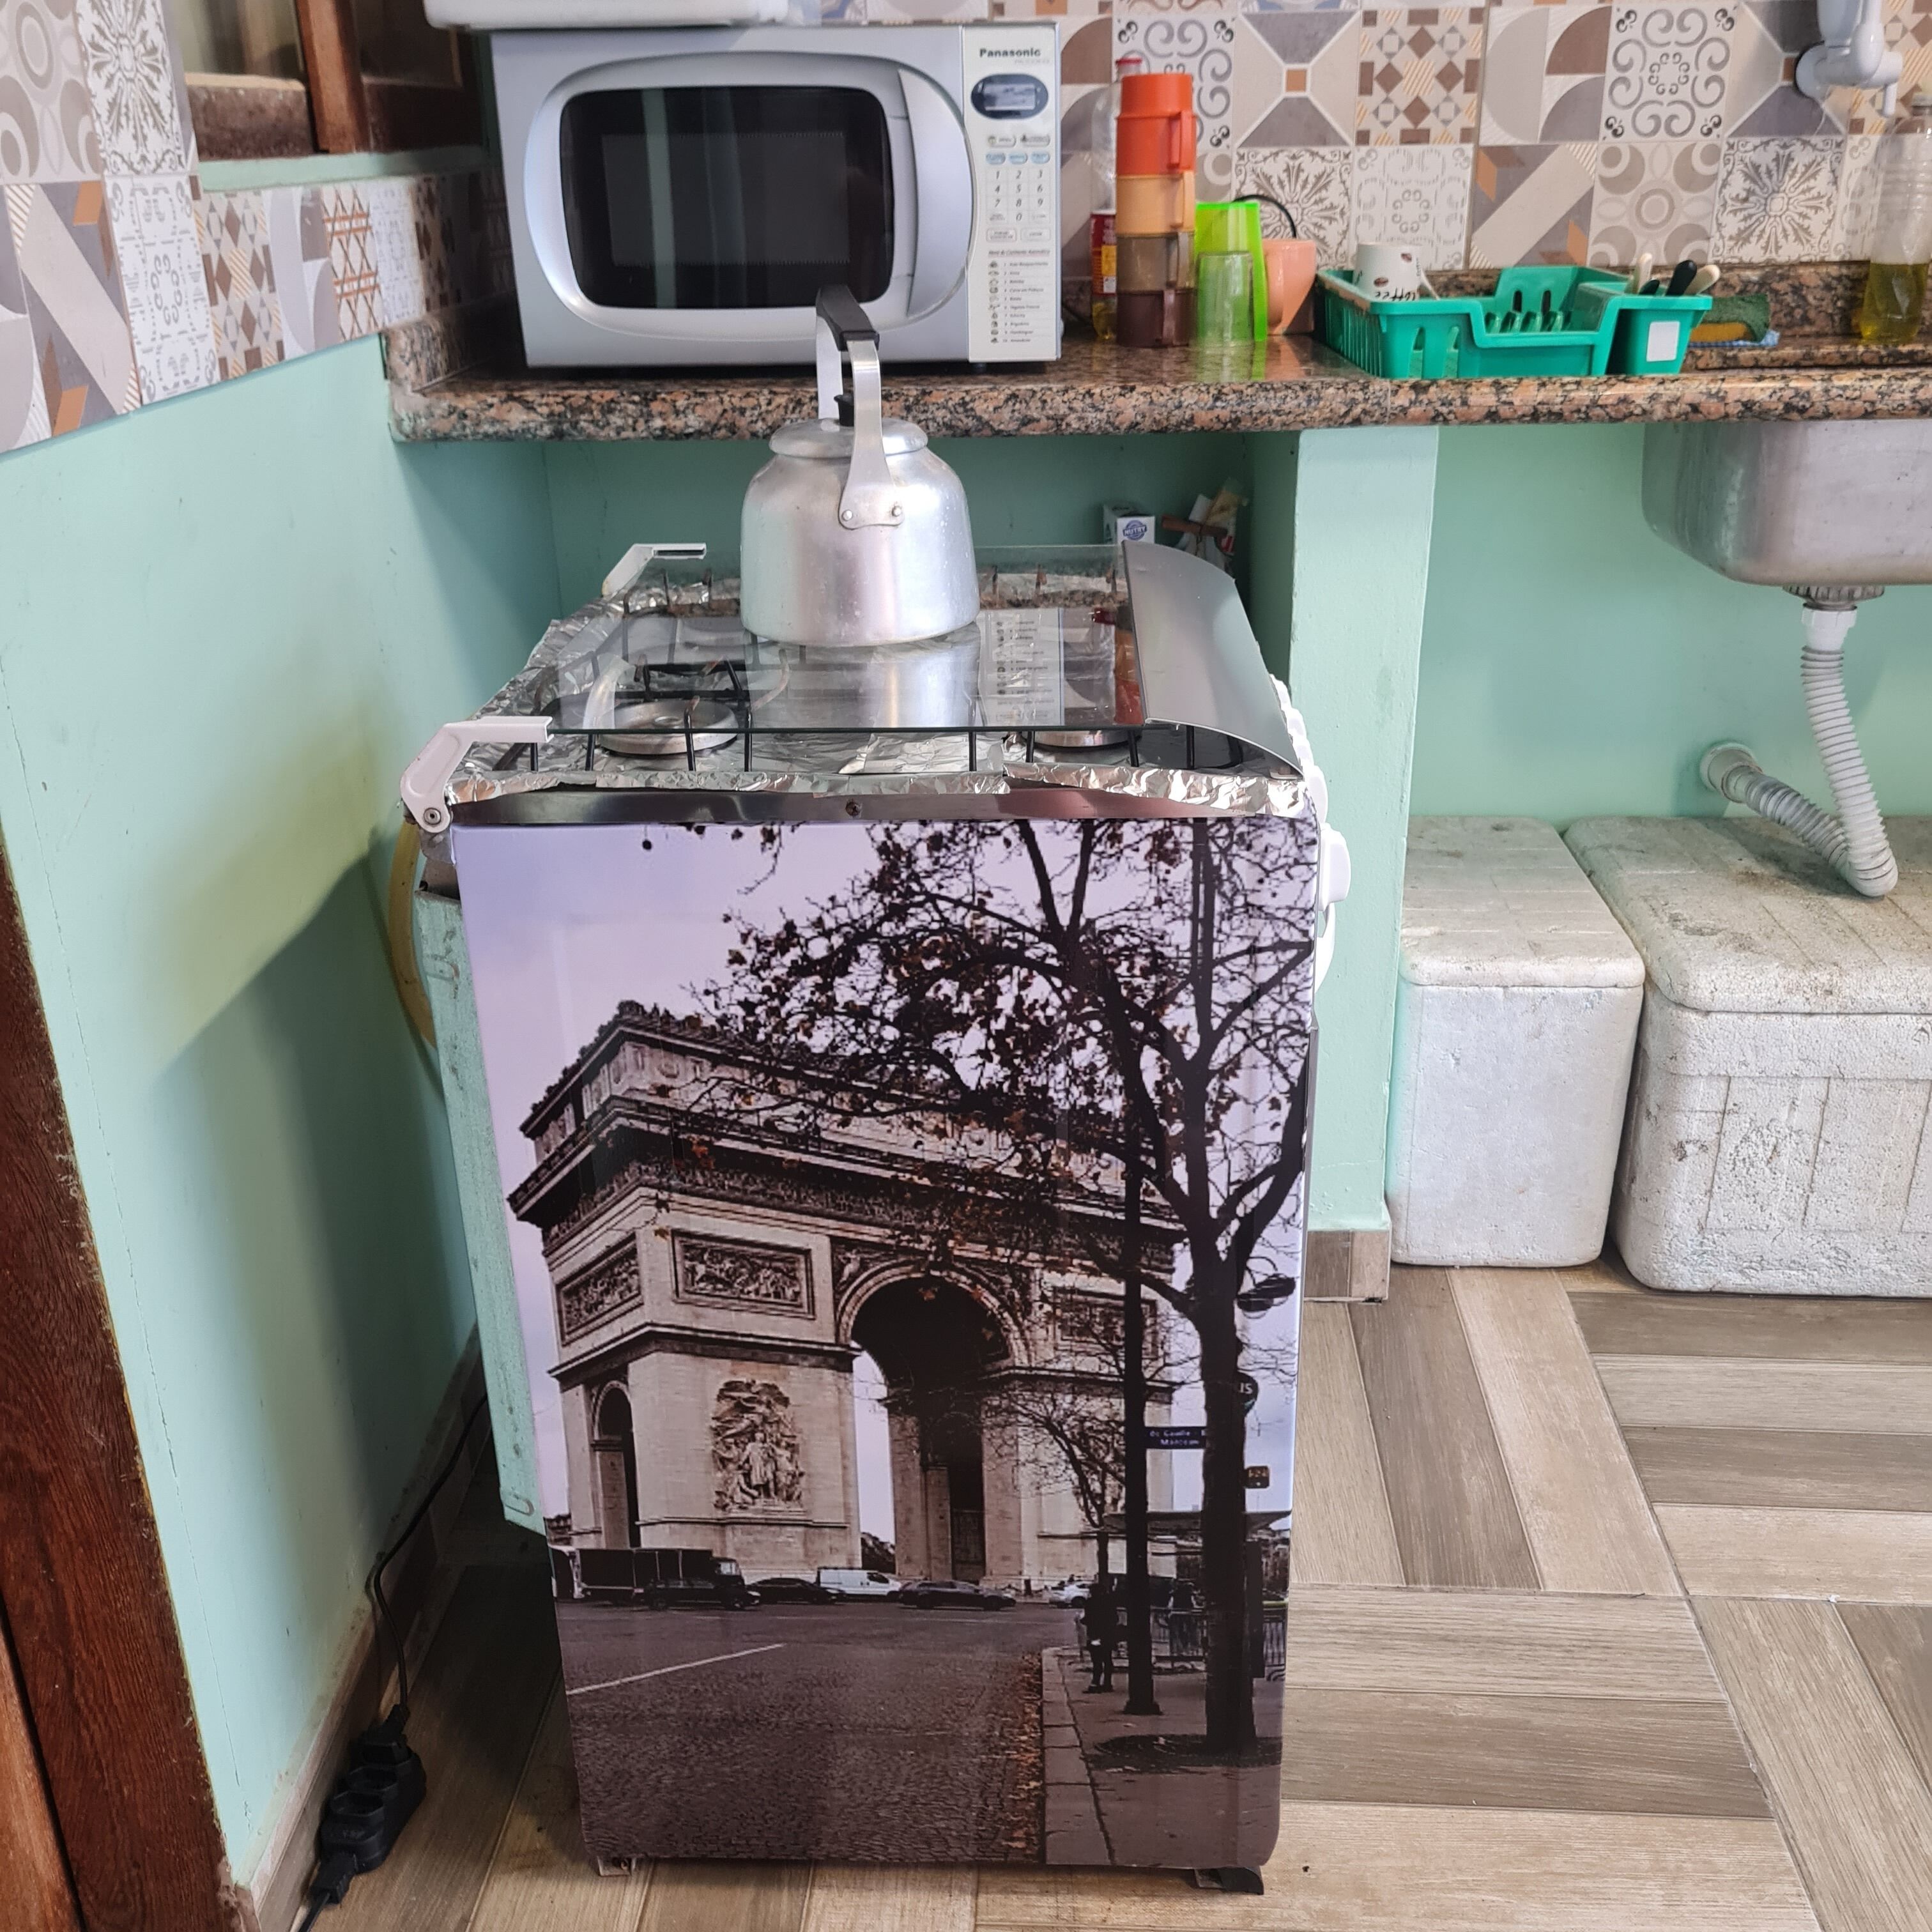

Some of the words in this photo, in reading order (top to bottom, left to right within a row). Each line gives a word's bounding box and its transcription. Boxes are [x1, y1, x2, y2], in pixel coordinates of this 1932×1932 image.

[979, 48, 1041, 57] Panasonic
[996, 171, 1000, 180] 1
[1016, 169, 1022, 180] 2
[1038, 169, 1043, 178] 3
[995, 185, 1000, 194] 4
[1016, 184, 1022, 193] 5
[1037, 184, 1043, 192] 6
[995, 199, 1000, 207] 7
[1016, 198, 1022, 207] 8
[1038, 198, 1043, 206] 9
[1016, 213, 1022, 221] 0
